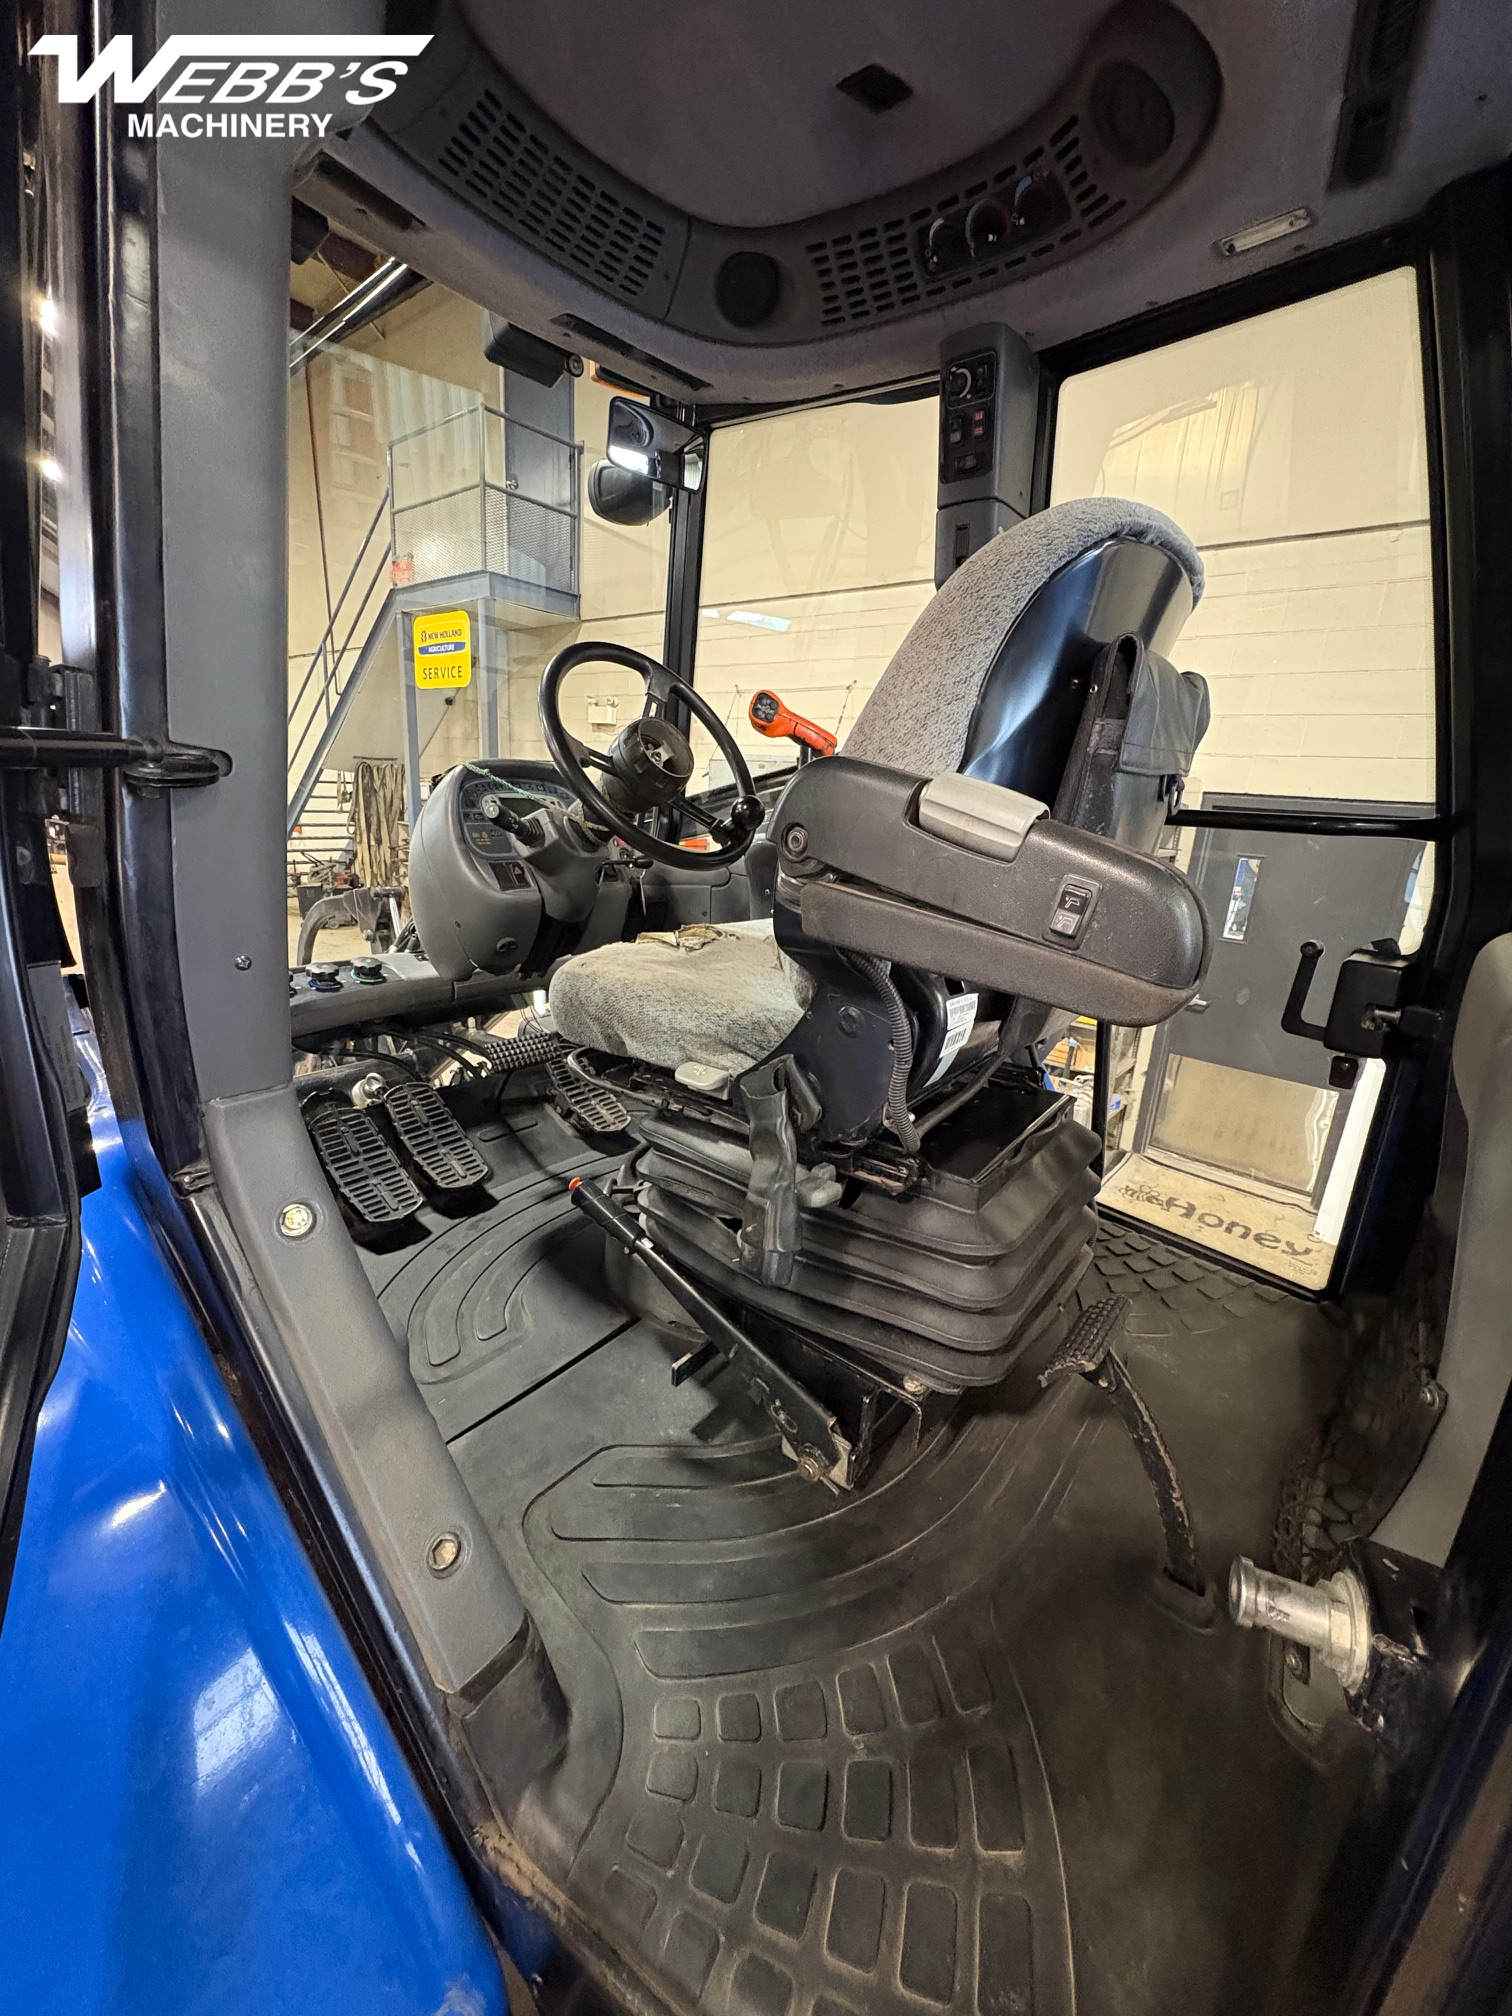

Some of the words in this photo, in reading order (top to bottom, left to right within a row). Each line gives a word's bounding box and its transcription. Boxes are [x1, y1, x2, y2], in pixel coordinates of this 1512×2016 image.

[428, 631, 439, 640] NEW
[440, 629, 462, 638] HOLLAND
[423, 666, 462, 680] SERVICE
[1162, 1196, 1313, 1256] Honey
